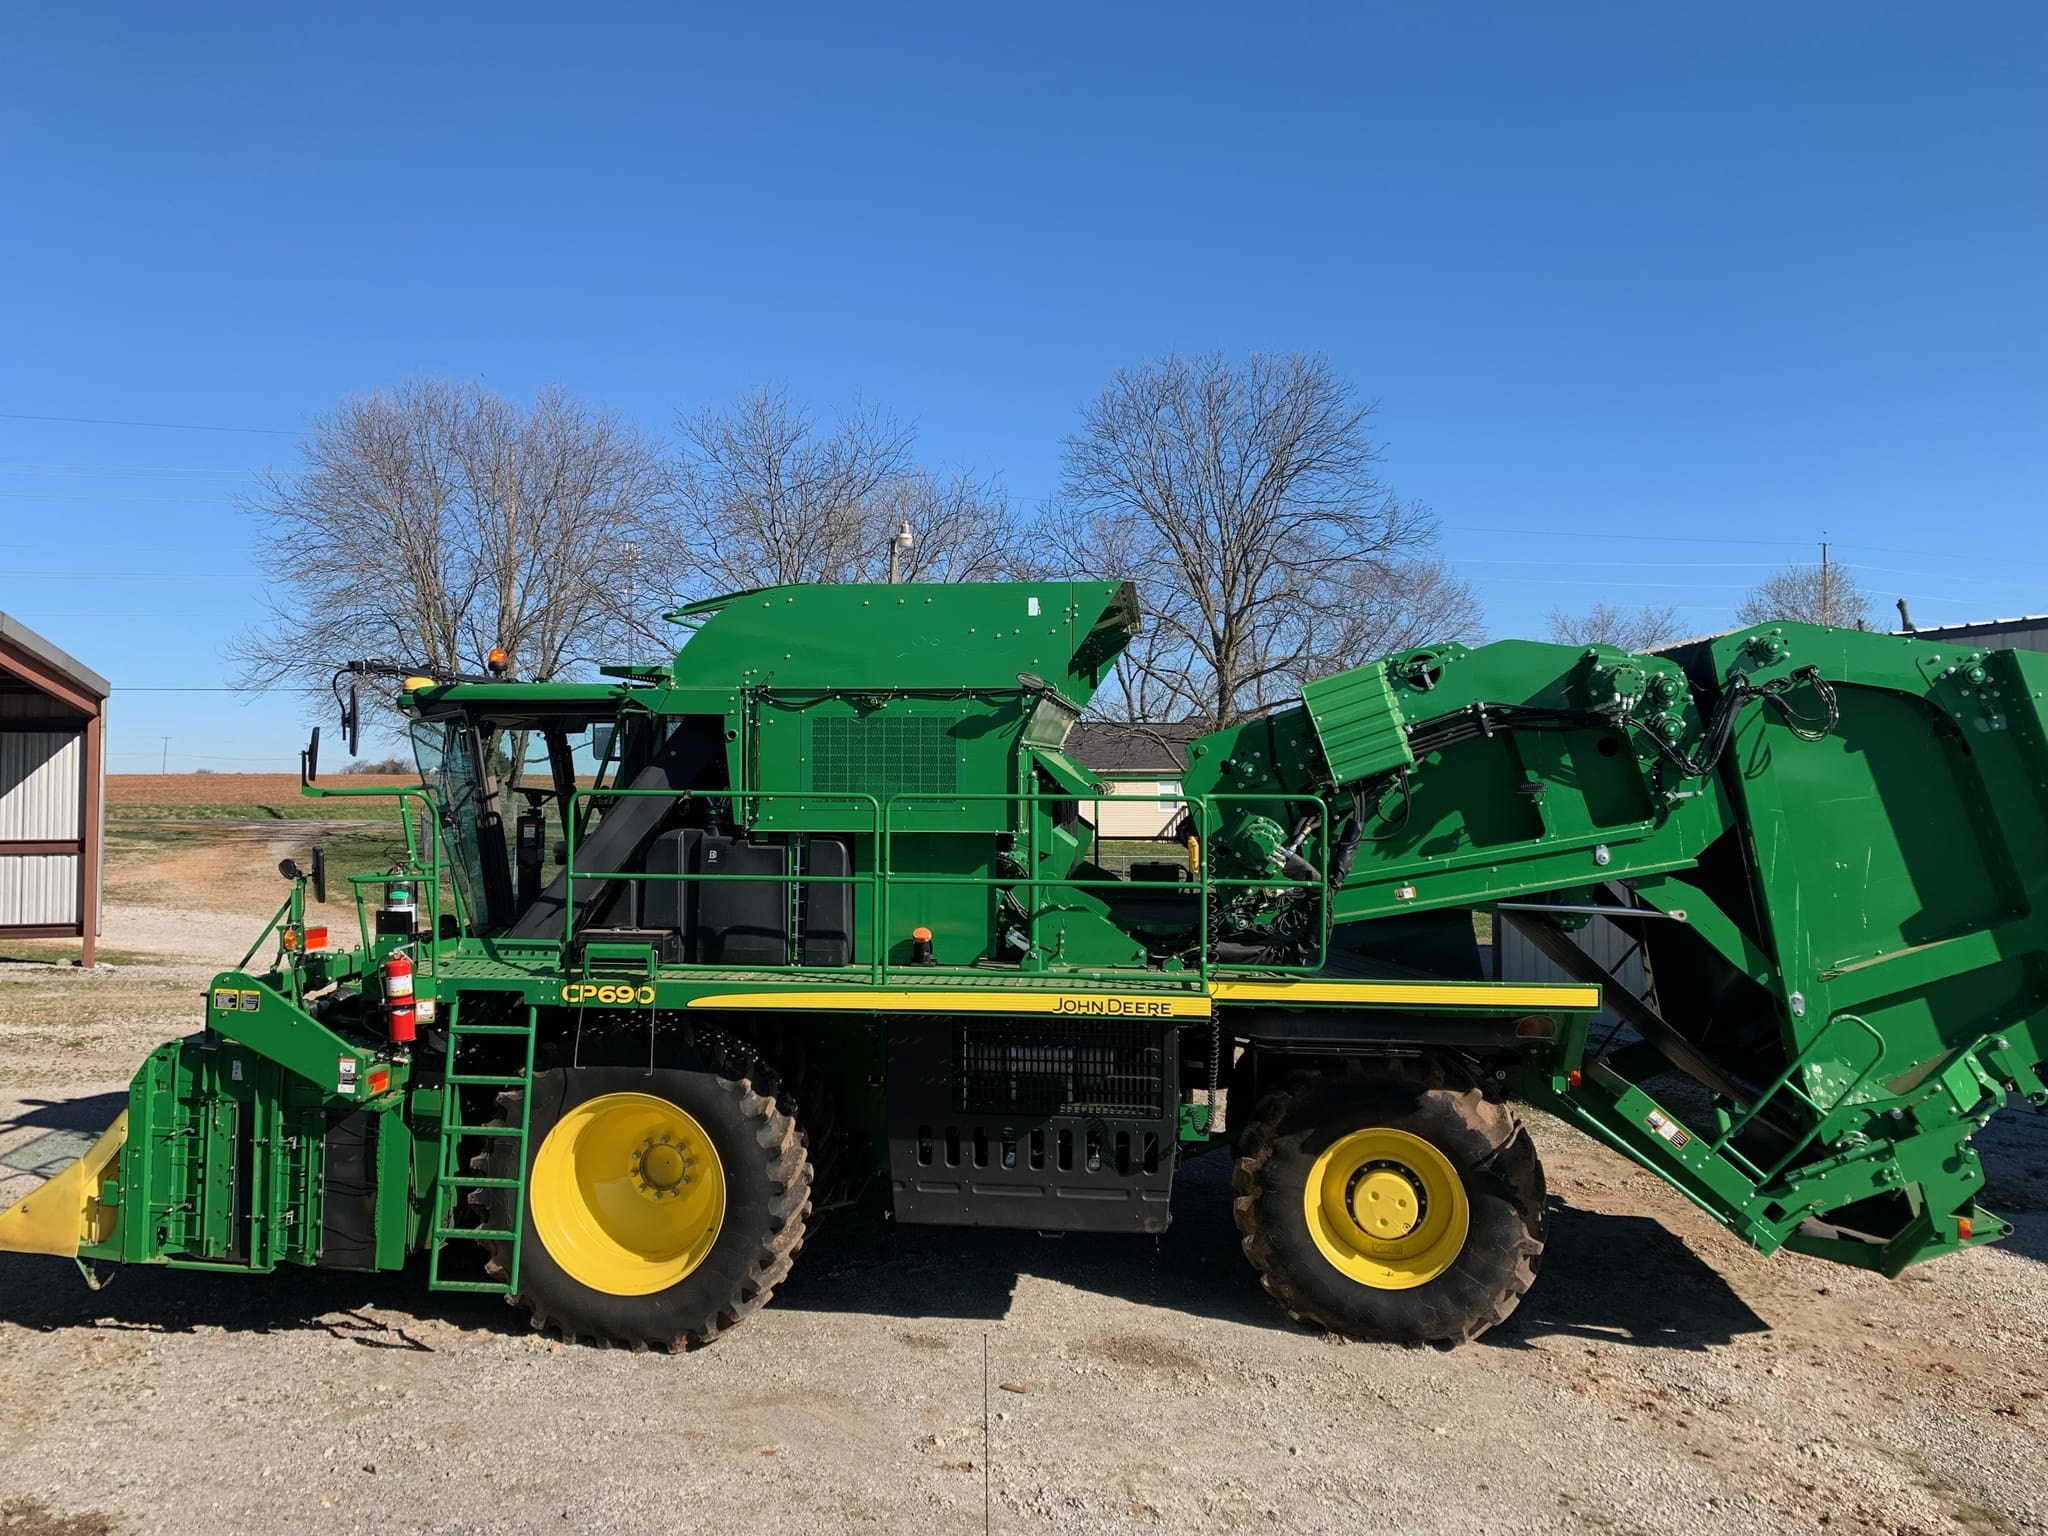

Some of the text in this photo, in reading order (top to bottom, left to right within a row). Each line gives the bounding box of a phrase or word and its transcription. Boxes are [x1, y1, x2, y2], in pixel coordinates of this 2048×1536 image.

[561, 984, 655, 1005] CP690
[1053, 997, 1172, 1015] JOHN DEERE
